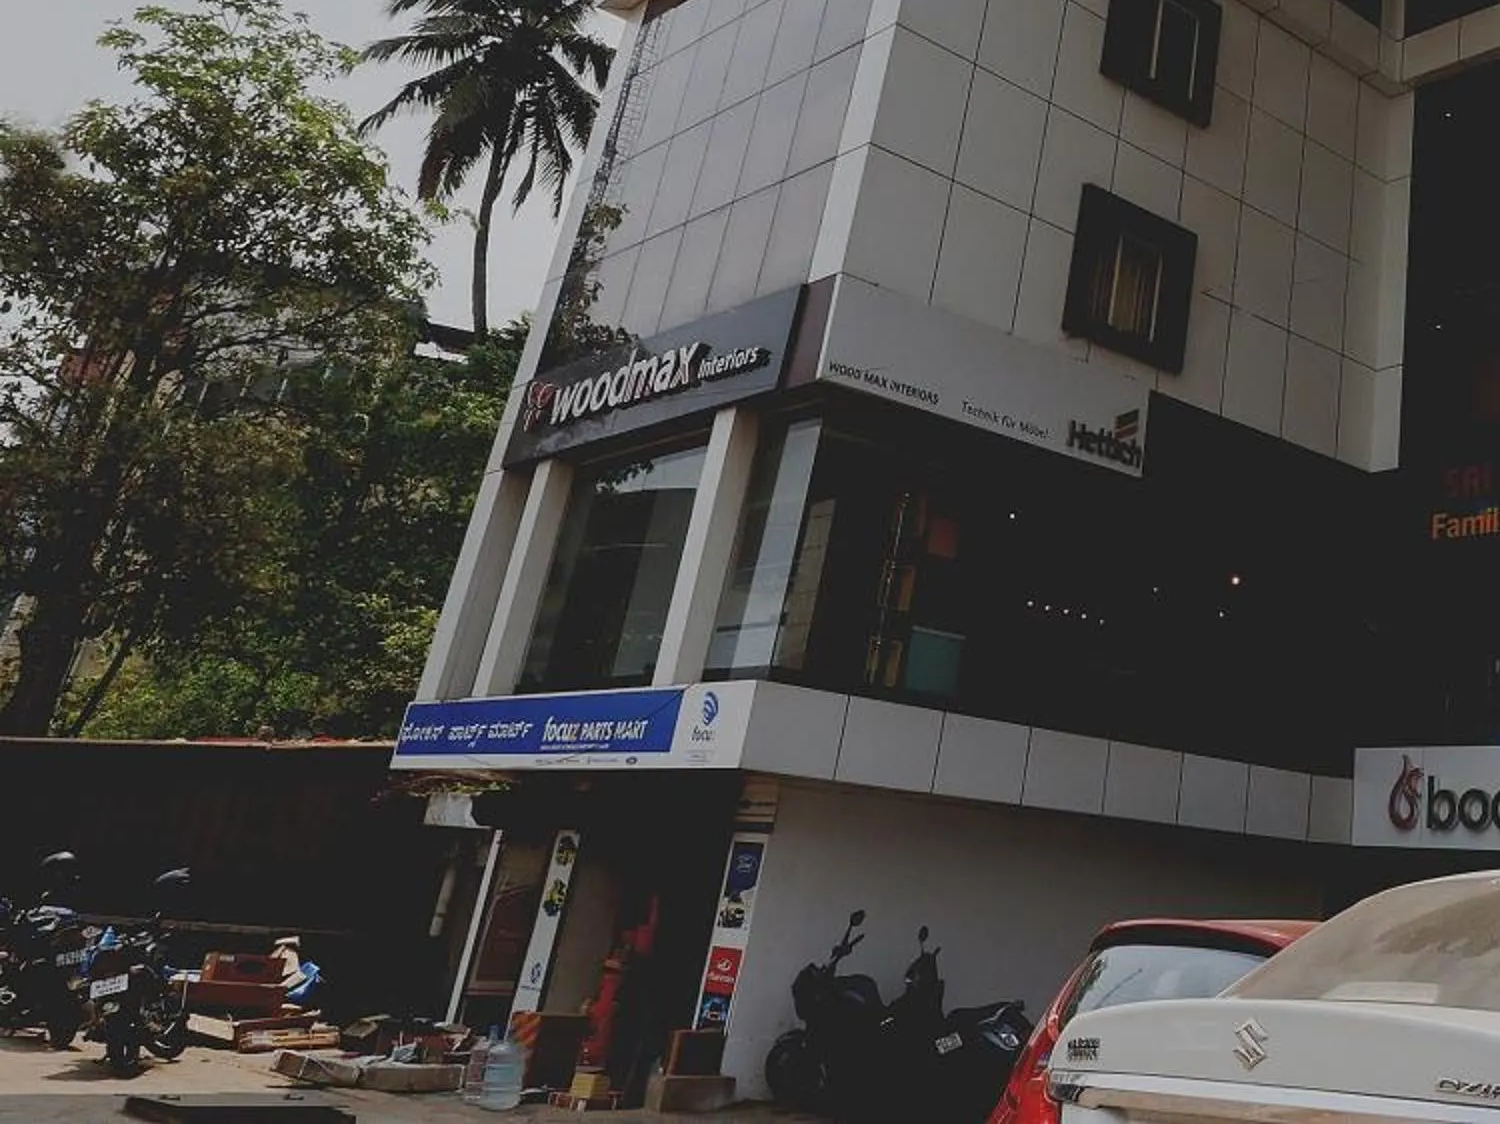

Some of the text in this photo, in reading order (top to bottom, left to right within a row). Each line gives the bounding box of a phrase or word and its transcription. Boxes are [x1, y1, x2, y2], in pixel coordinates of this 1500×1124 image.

[551, 342, 701, 425] woodmax
[828, 360, 861, 382] WOOD
[863, 370, 888, 390] MAX
[580, 721, 614, 742] PARTS
[613, 720, 648, 741] MART
